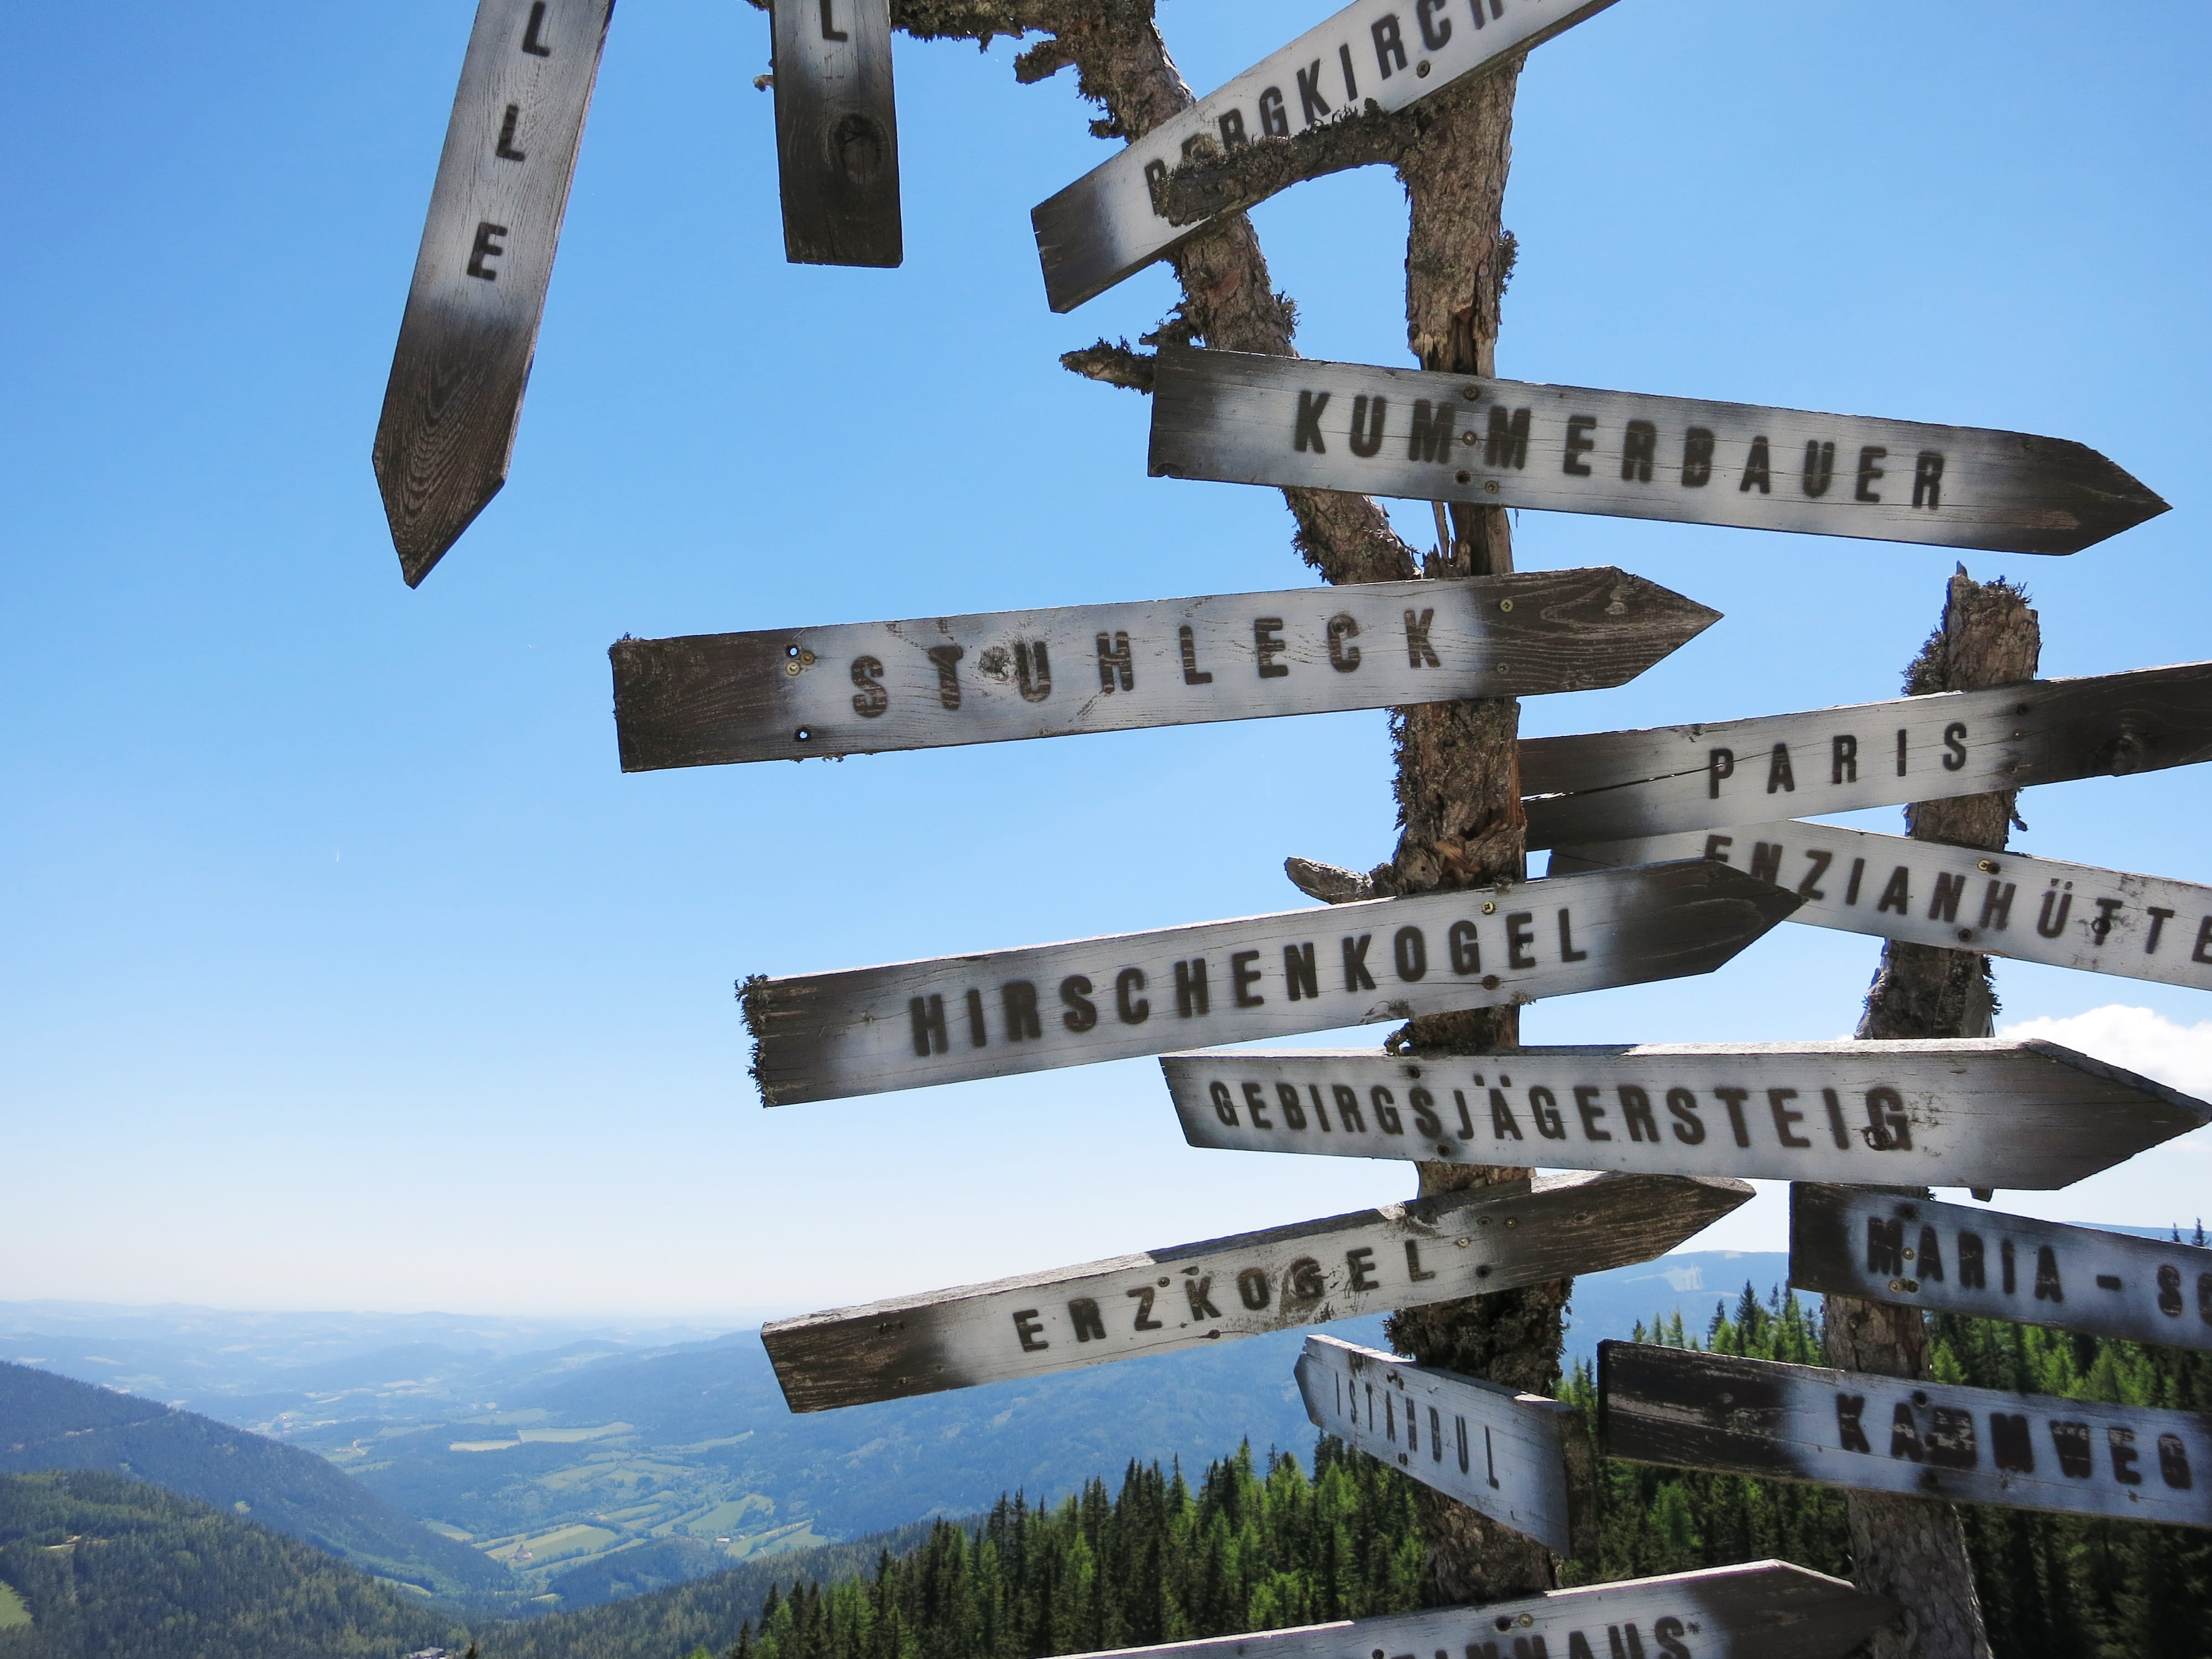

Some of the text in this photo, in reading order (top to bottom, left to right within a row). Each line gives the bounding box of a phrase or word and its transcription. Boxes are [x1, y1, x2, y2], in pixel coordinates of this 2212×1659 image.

[1293, 388, 1948, 511] KUMMERBAUER
[851, 607, 1442, 718] STUHLECK
[1709, 721, 1969, 800] PARIS
[908, 907, 1589, 1058] HIRSCHENKOGEL
[1208, 1073, 1916, 1154] GEBIRGSJÄGERSTEIG
[1012, 1239, 1436, 1353] ERZKOGEL
[1335, 1371, 1500, 1491] ISTANBUL
